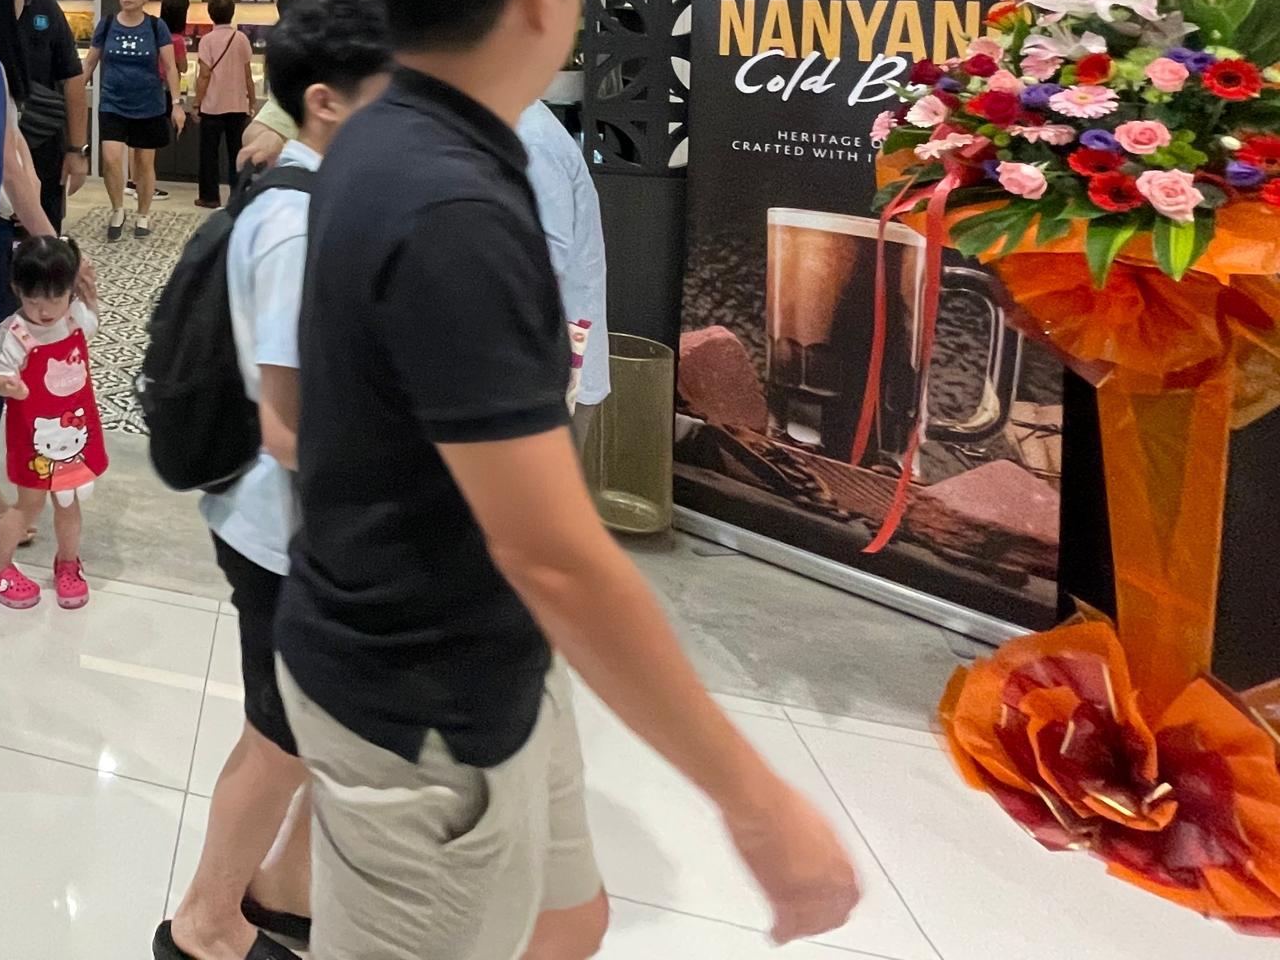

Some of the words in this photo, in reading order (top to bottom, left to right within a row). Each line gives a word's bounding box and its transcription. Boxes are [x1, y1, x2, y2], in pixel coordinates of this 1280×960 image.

[734, 49, 841, 102] Cold
[777, 130, 862, 148] HERITAGE
[731, 140, 805, 157] CRAFTED
[812, 148, 859, 162] WITH
